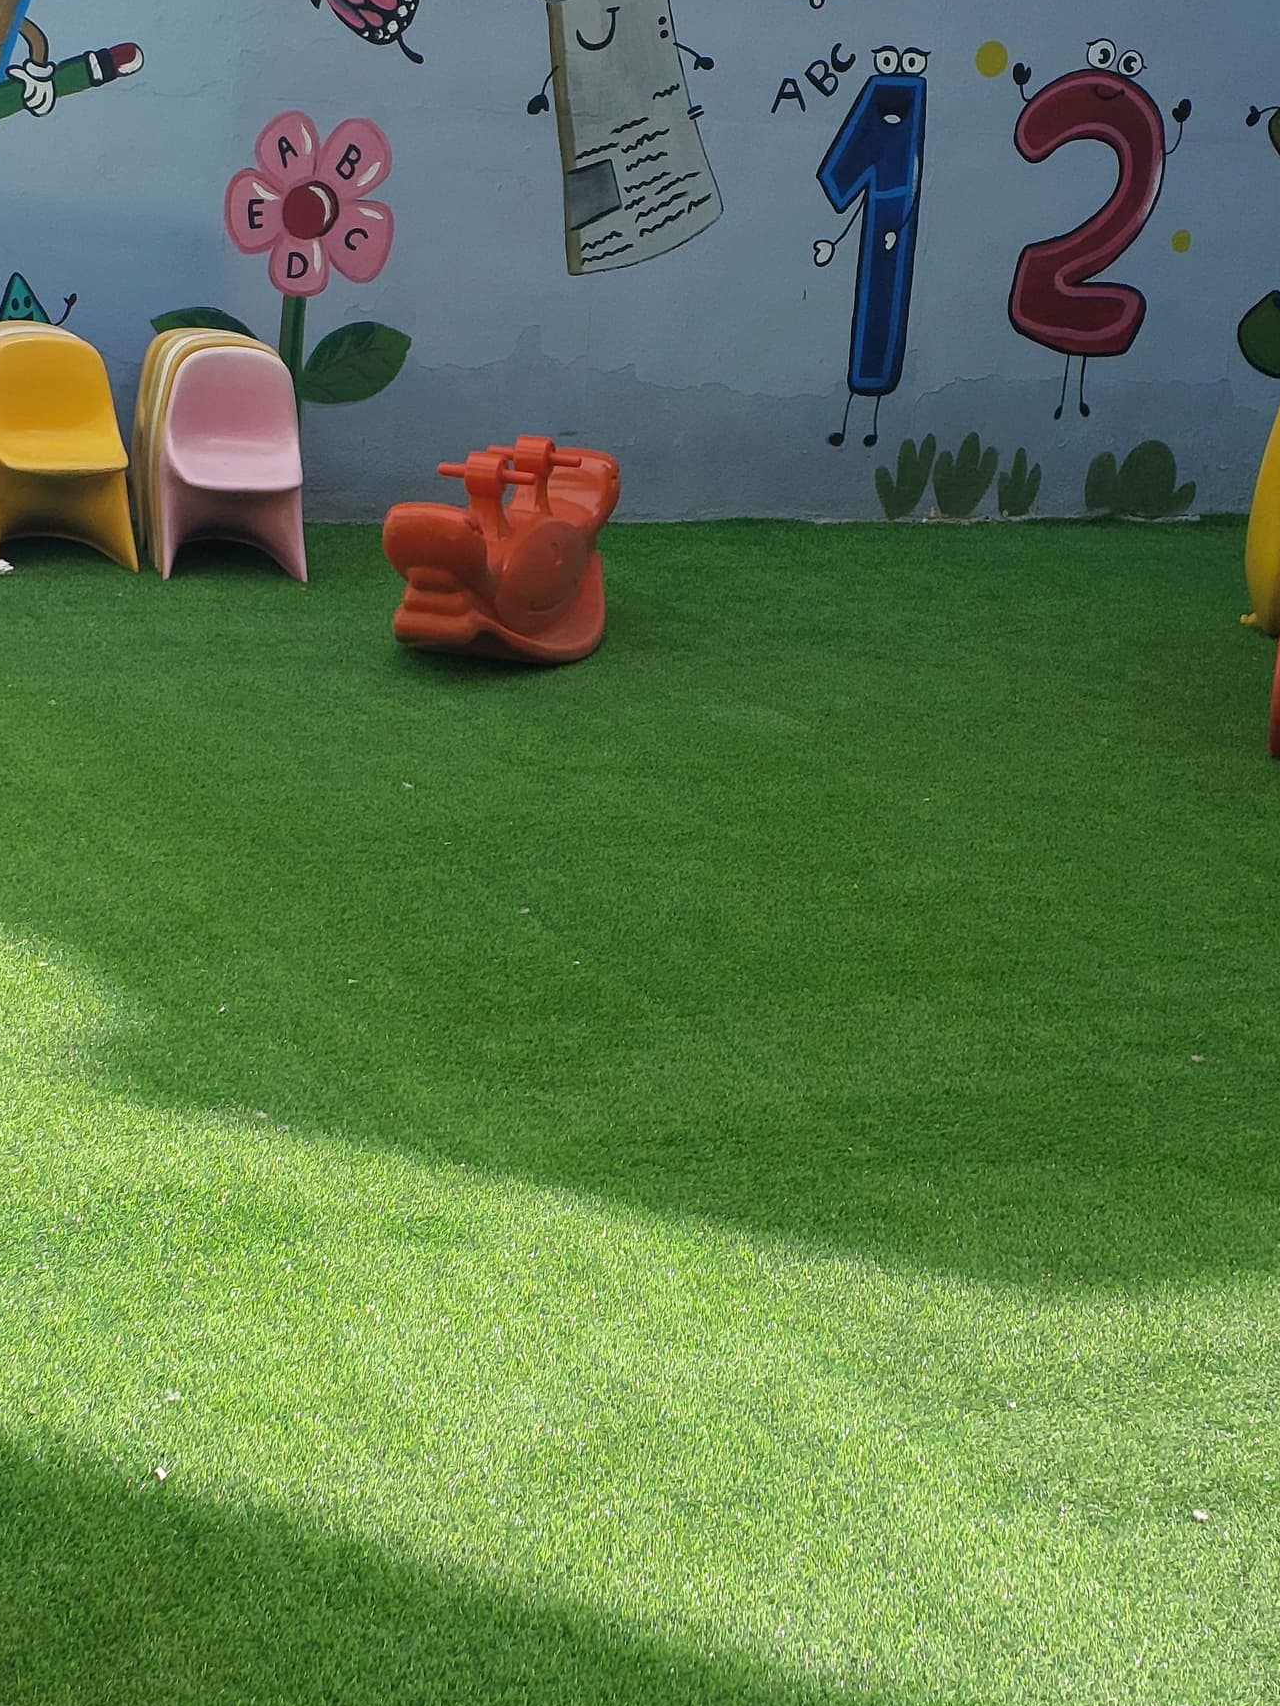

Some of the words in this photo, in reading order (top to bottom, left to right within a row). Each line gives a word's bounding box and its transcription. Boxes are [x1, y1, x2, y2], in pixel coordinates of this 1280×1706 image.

[770, 42, 857, 114] ABC
[277, 135, 299, 170] A
[335, 143, 362, 181] B
[247, 198, 265, 230] E
[344, 227, 369, 252] C
[816, 73, 927, 398] 1
[1008, 67, 1166, 357] 2
[286, 251, 309, 280] D
